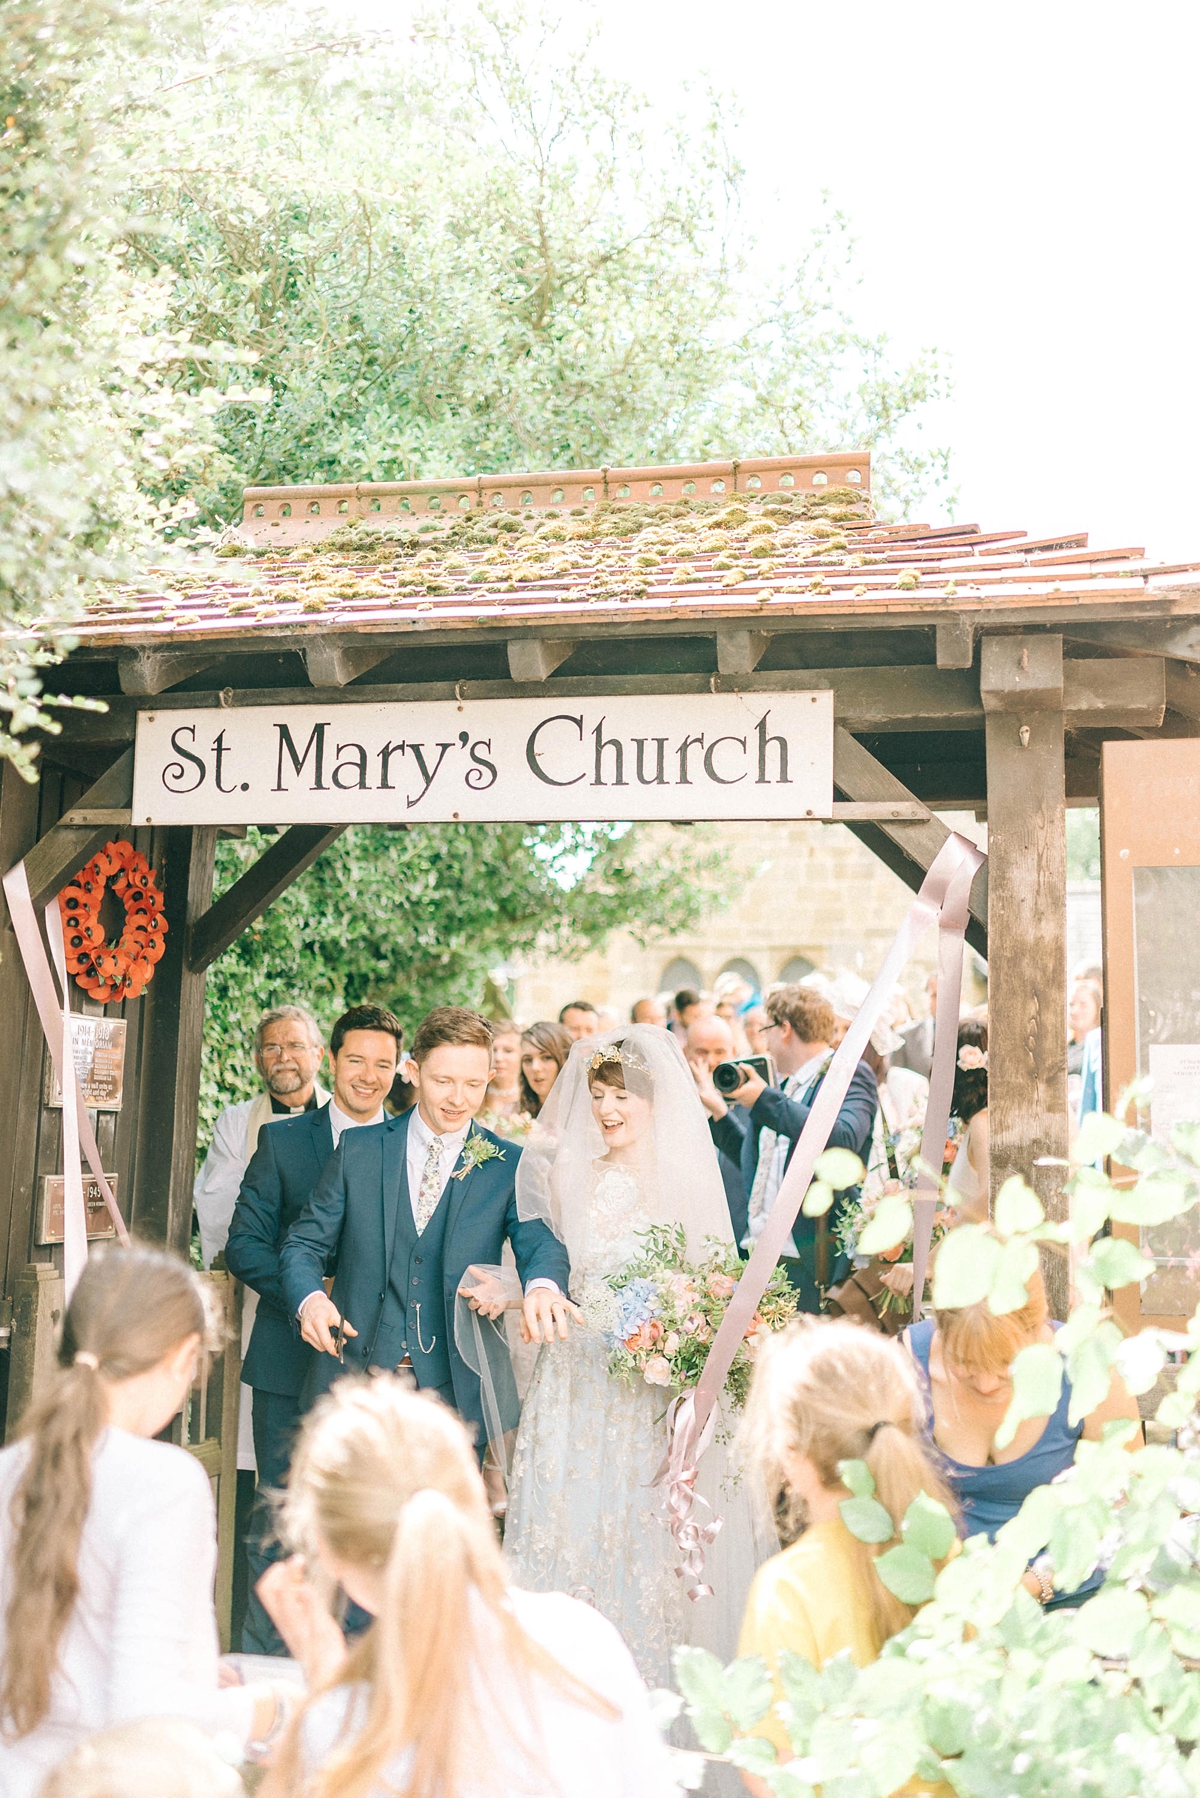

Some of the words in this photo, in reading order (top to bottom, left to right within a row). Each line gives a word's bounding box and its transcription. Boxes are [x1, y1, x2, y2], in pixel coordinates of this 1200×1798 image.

[162, 724, 250, 794] St.
[270, 722, 498, 809] Mary's
[525, 709, 794, 787] Church
